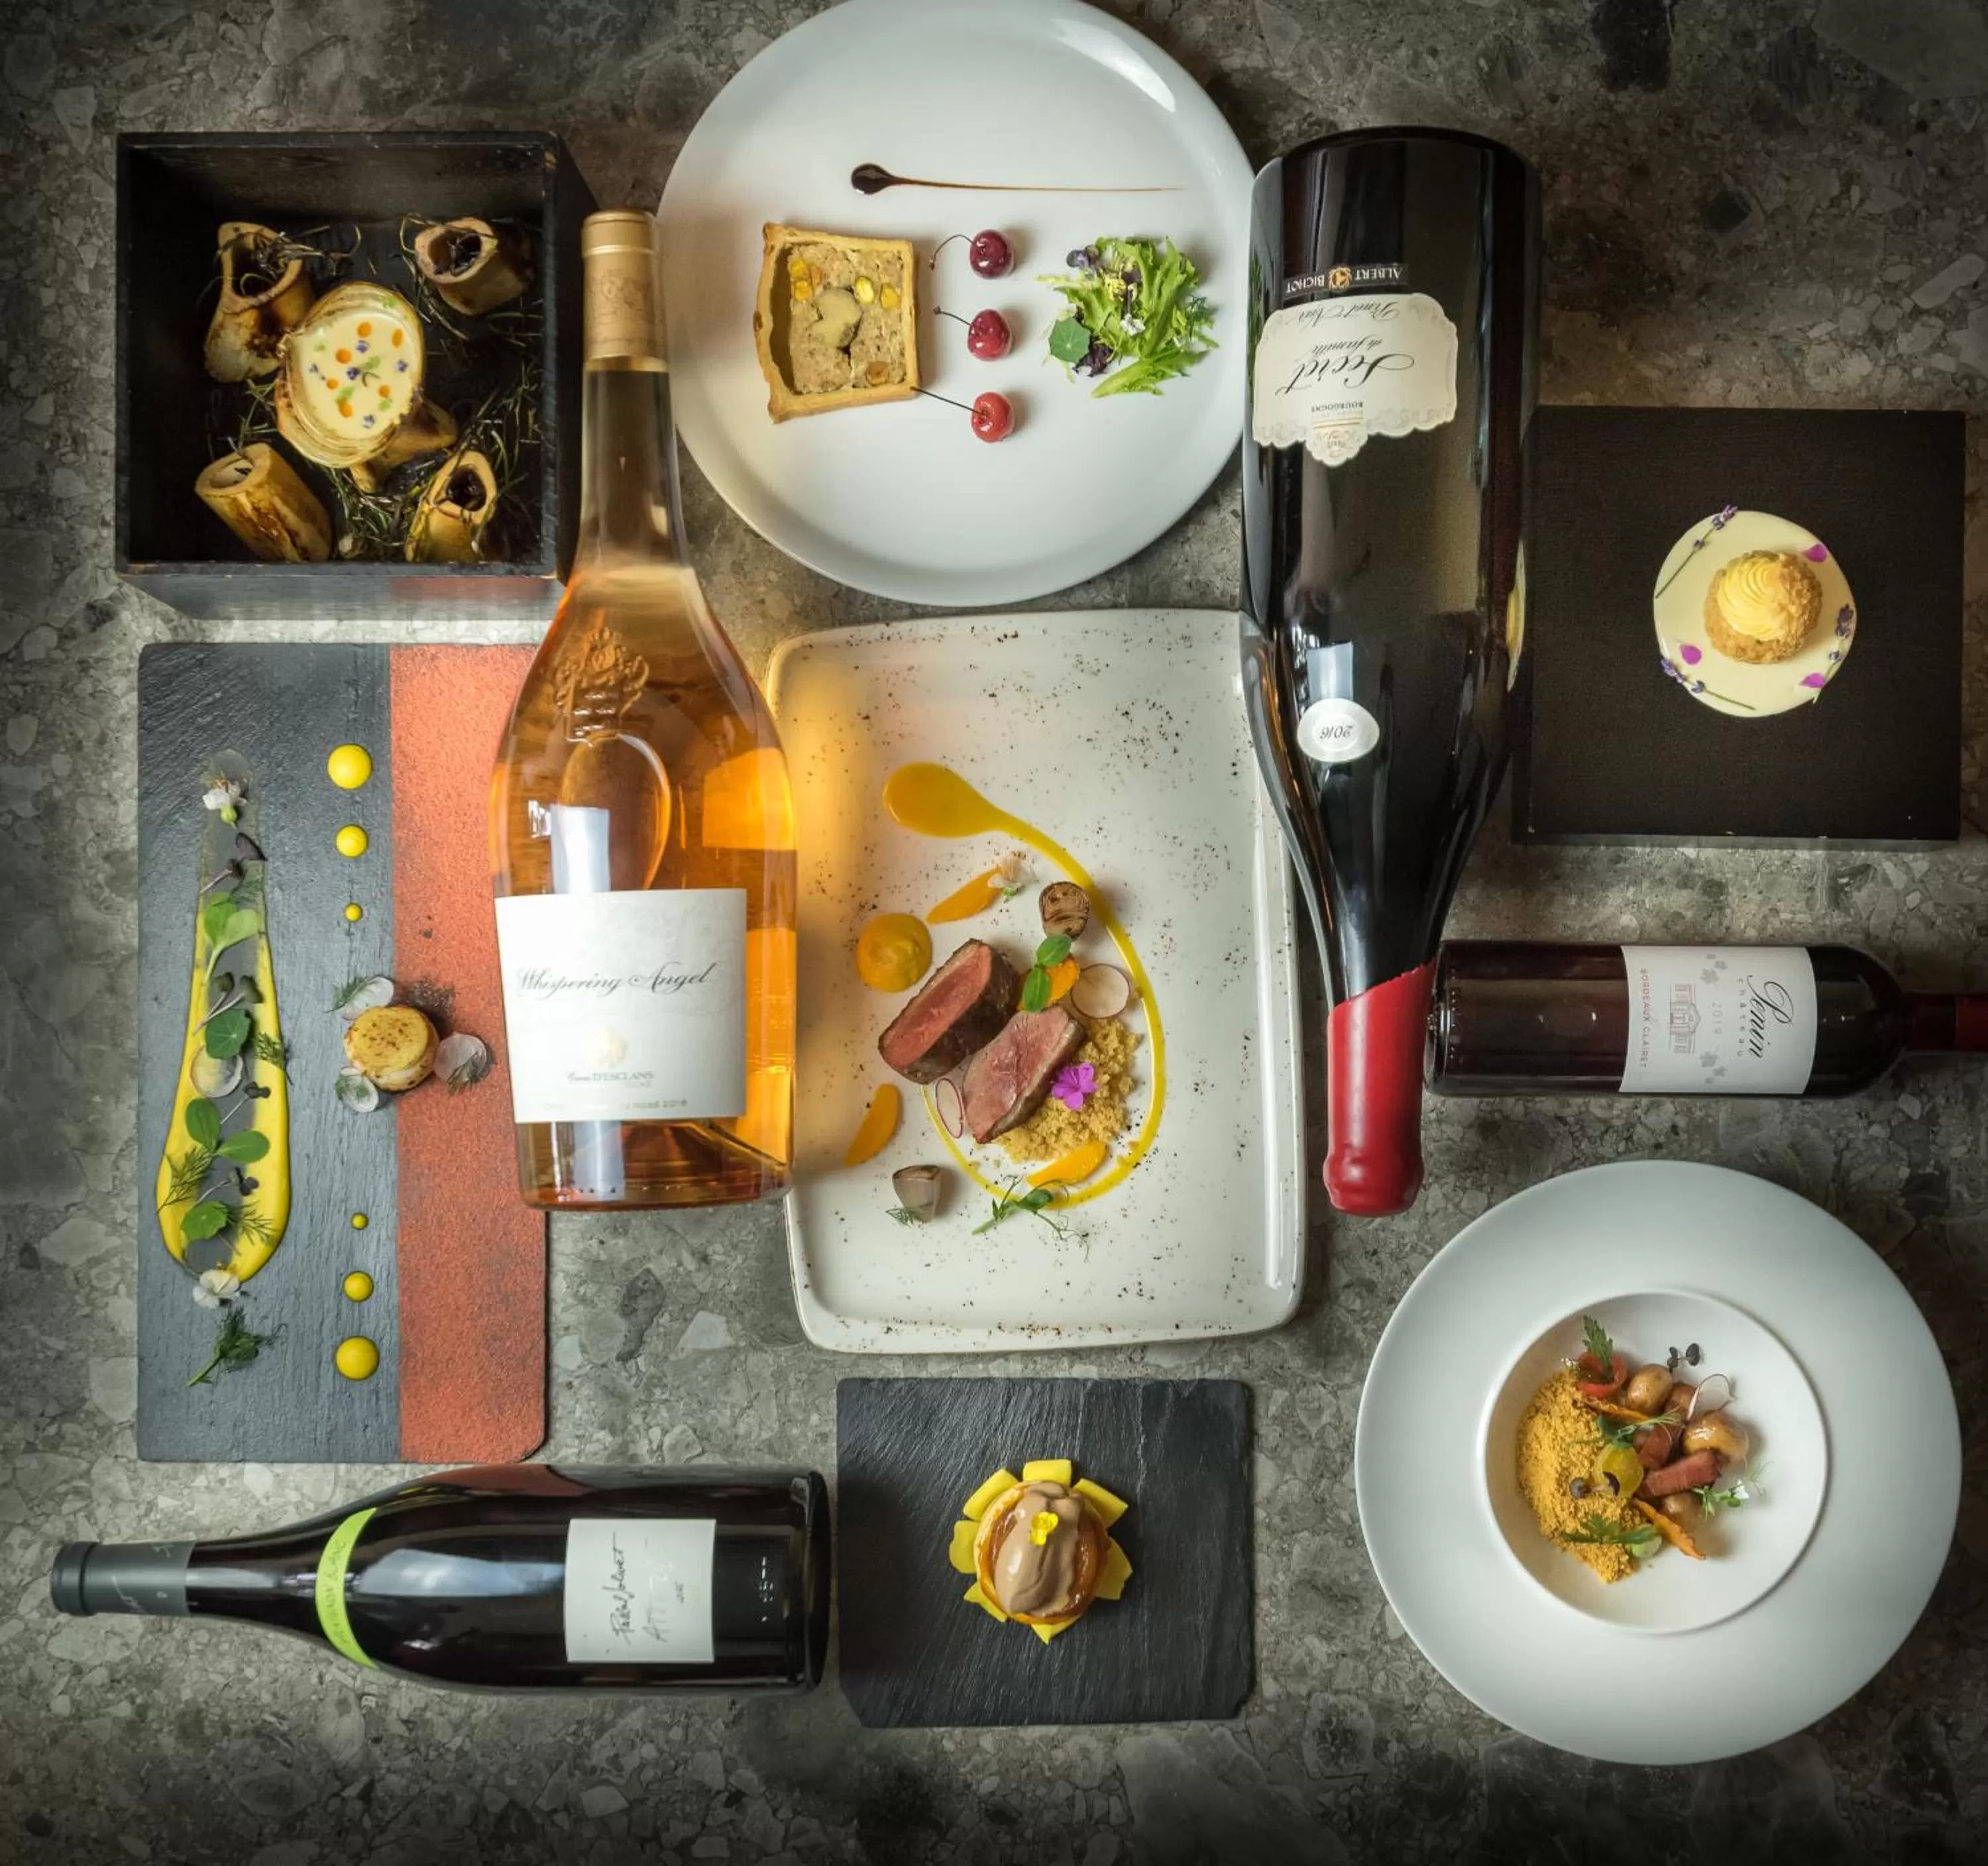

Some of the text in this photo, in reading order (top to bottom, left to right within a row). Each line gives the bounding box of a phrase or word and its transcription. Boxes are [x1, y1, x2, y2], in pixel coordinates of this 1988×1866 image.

[1285, 266, 1402, 294] ALBERT BICHOT
[1275, 353, 1415, 397] Secret
[516, 961, 718, 1001] Whispering Angel
[1639, 968, 1651, 1022] BORDEAUX
